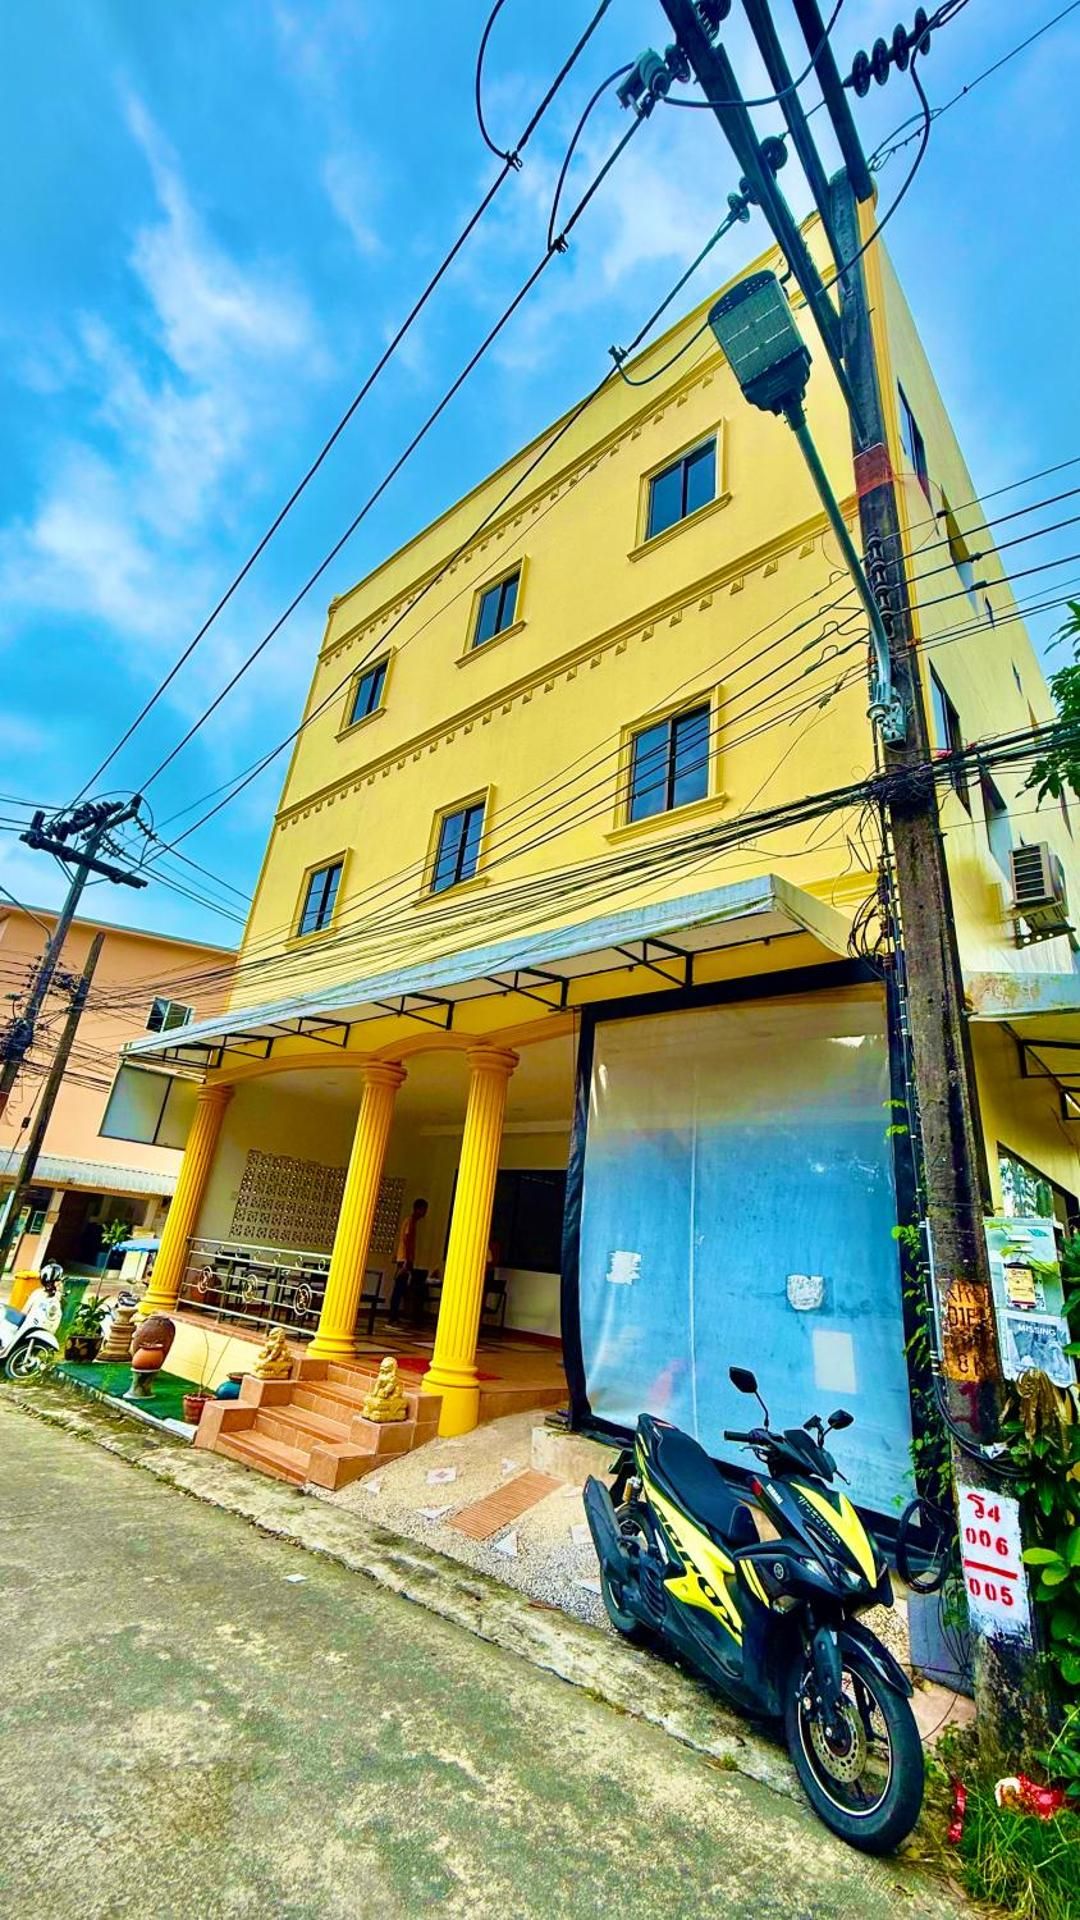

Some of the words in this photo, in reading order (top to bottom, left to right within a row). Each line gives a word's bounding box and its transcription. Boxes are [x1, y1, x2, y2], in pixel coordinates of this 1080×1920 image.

[1018, 1323, 1056, 1337] MISSING
[965, 1528, 1009, 1556] 006
[968, 1578, 1014, 1607] 005
